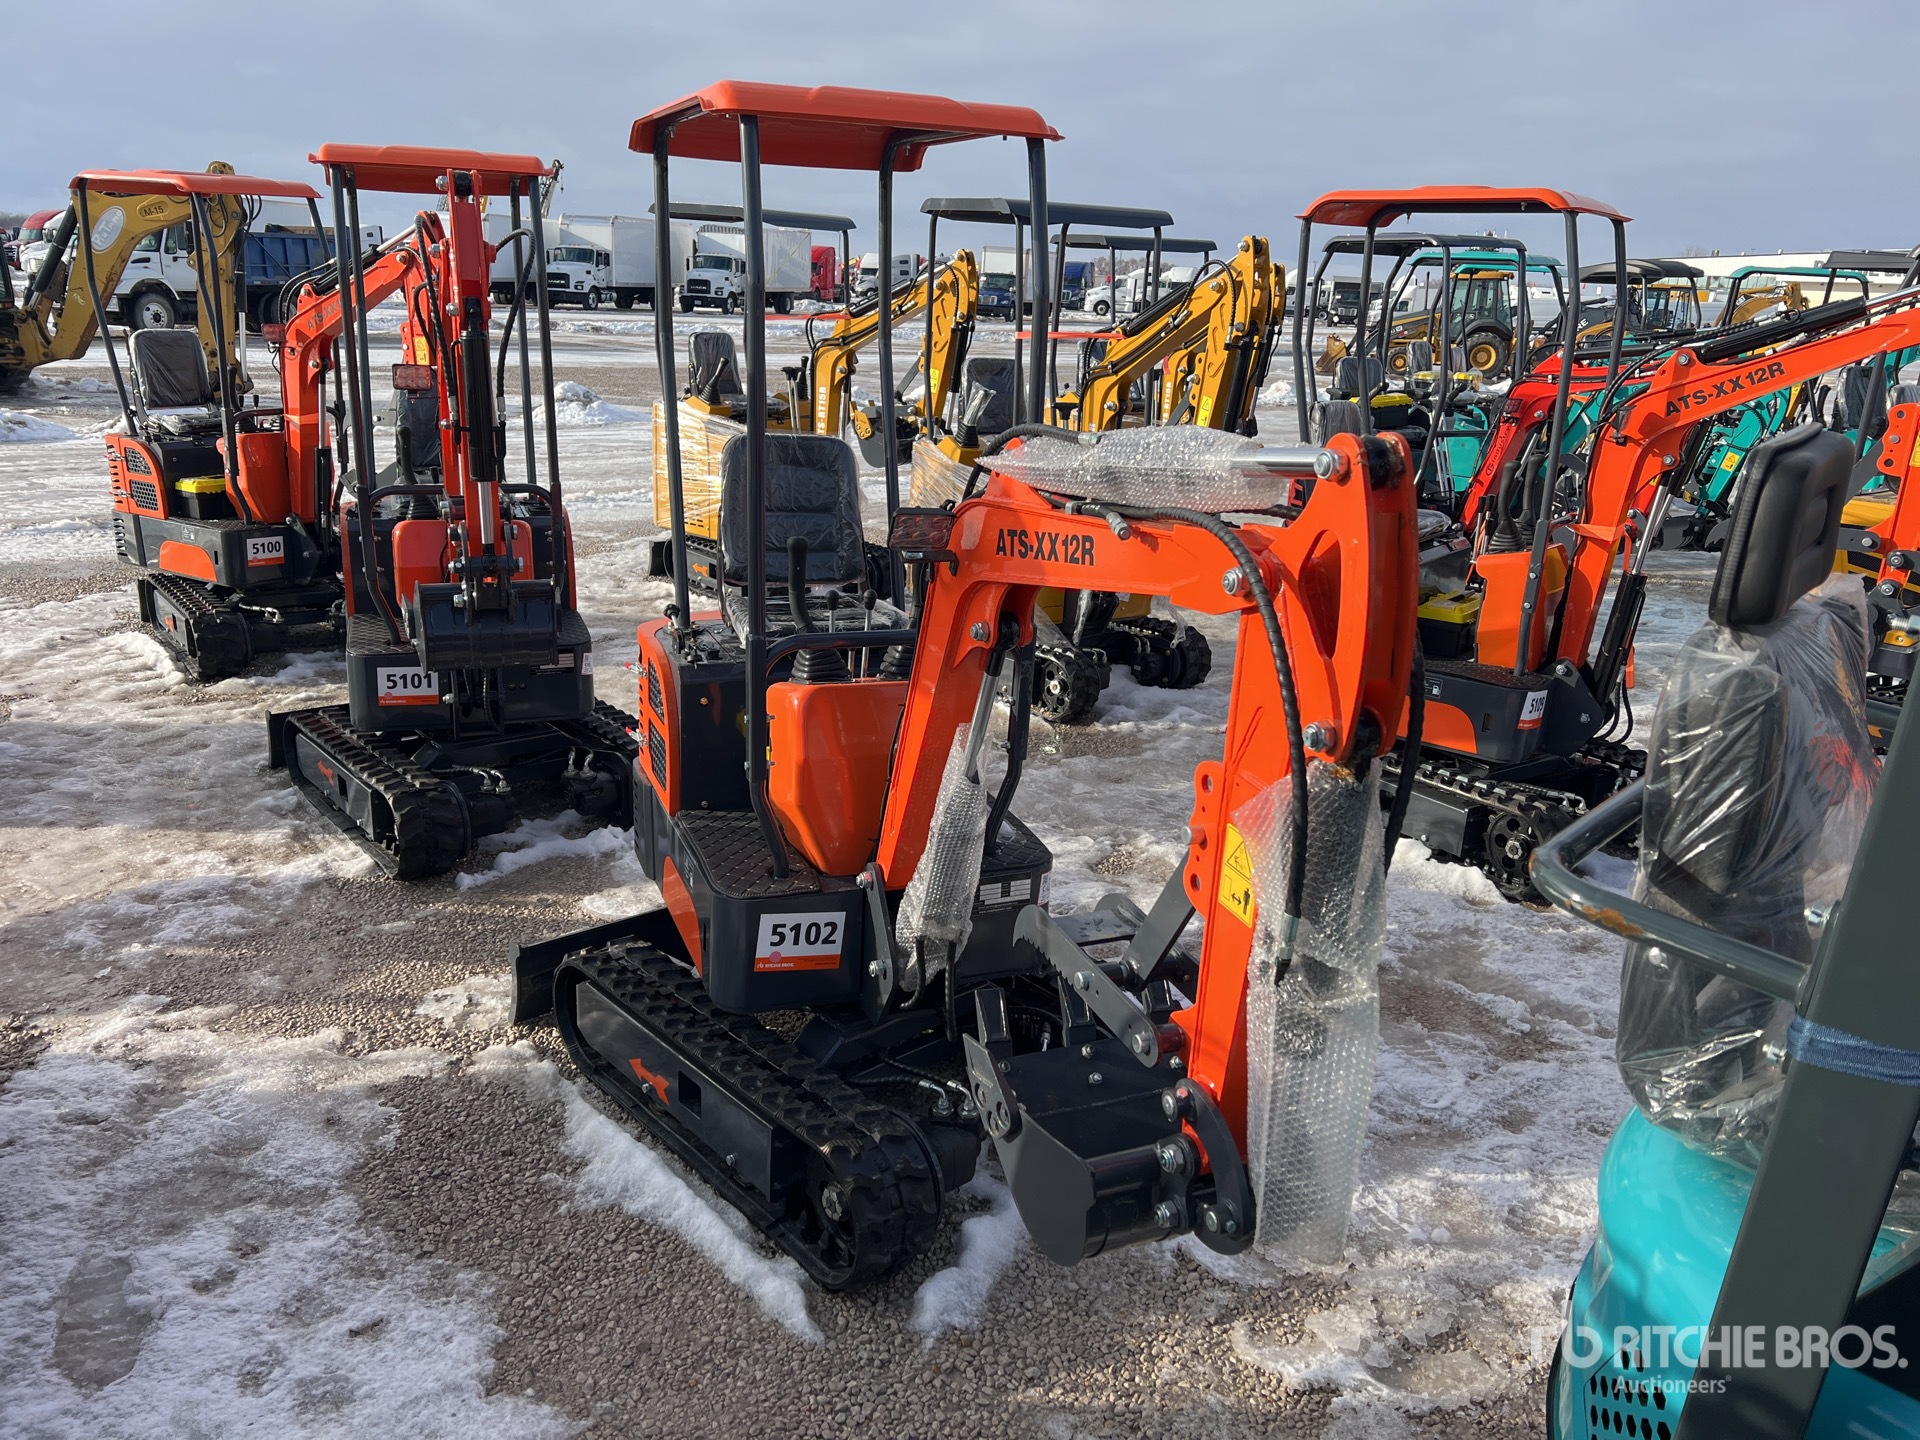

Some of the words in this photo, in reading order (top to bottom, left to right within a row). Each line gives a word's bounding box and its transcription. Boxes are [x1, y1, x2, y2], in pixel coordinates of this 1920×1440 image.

[144, 206, 164, 217] M-15
[817, 386, 827, 435] TS-RT15R
[252, 540, 282, 555] 5100
[386, 672, 432, 690] 5101
[769, 921, 839, 947] 5102
